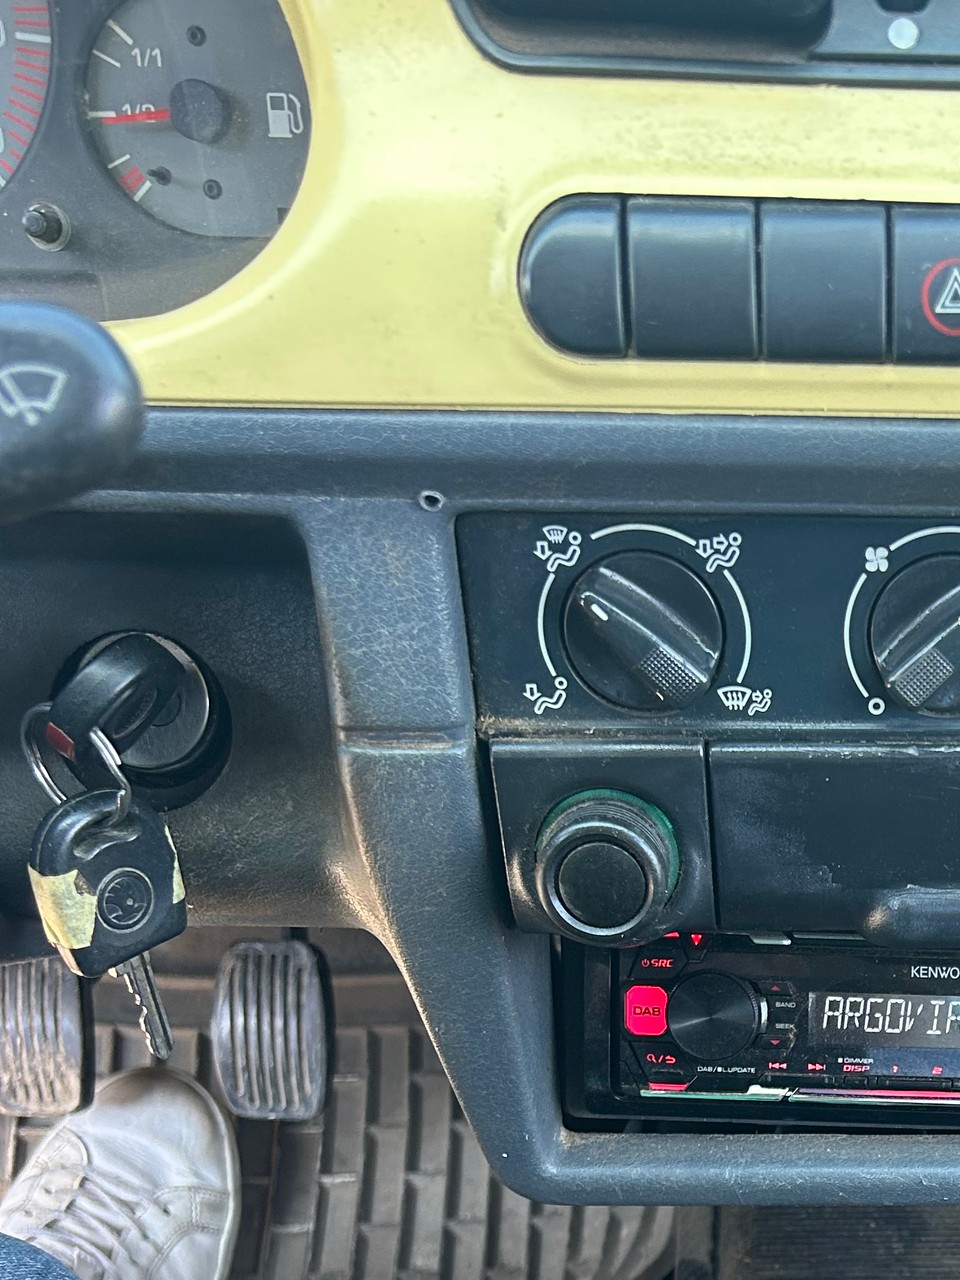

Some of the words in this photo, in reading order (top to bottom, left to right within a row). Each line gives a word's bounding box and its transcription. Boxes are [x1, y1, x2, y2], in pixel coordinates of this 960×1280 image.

[131, 48, 163, 68] 1/1
[650, 958, 674, 968] SRC
[632, 1005, 662, 1017] DAB
[843, 1064, 870, 1072] DISP
[932, 1066, 943, 1075] 2
